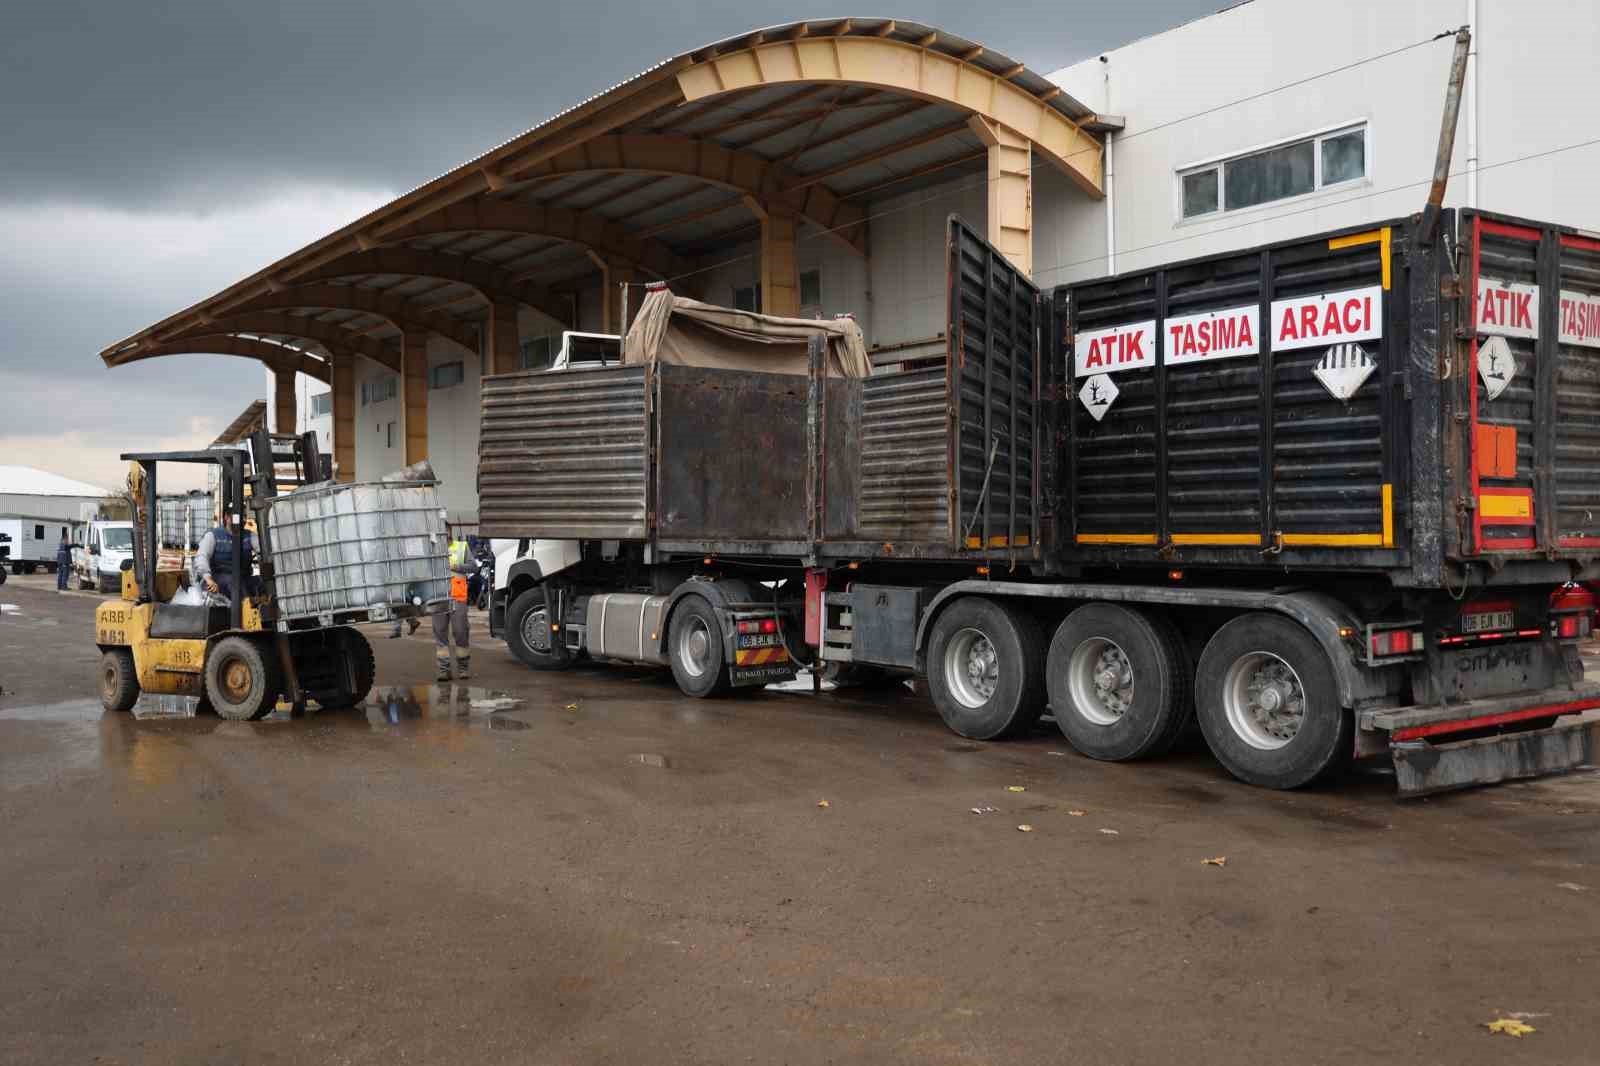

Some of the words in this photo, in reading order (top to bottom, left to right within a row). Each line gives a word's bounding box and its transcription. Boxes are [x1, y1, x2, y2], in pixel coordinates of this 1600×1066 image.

[1085, 330, 1145, 369] ATIK
[1279, 296, 1371, 342] ARACI
[1481, 288, 1533, 330] ATIK
